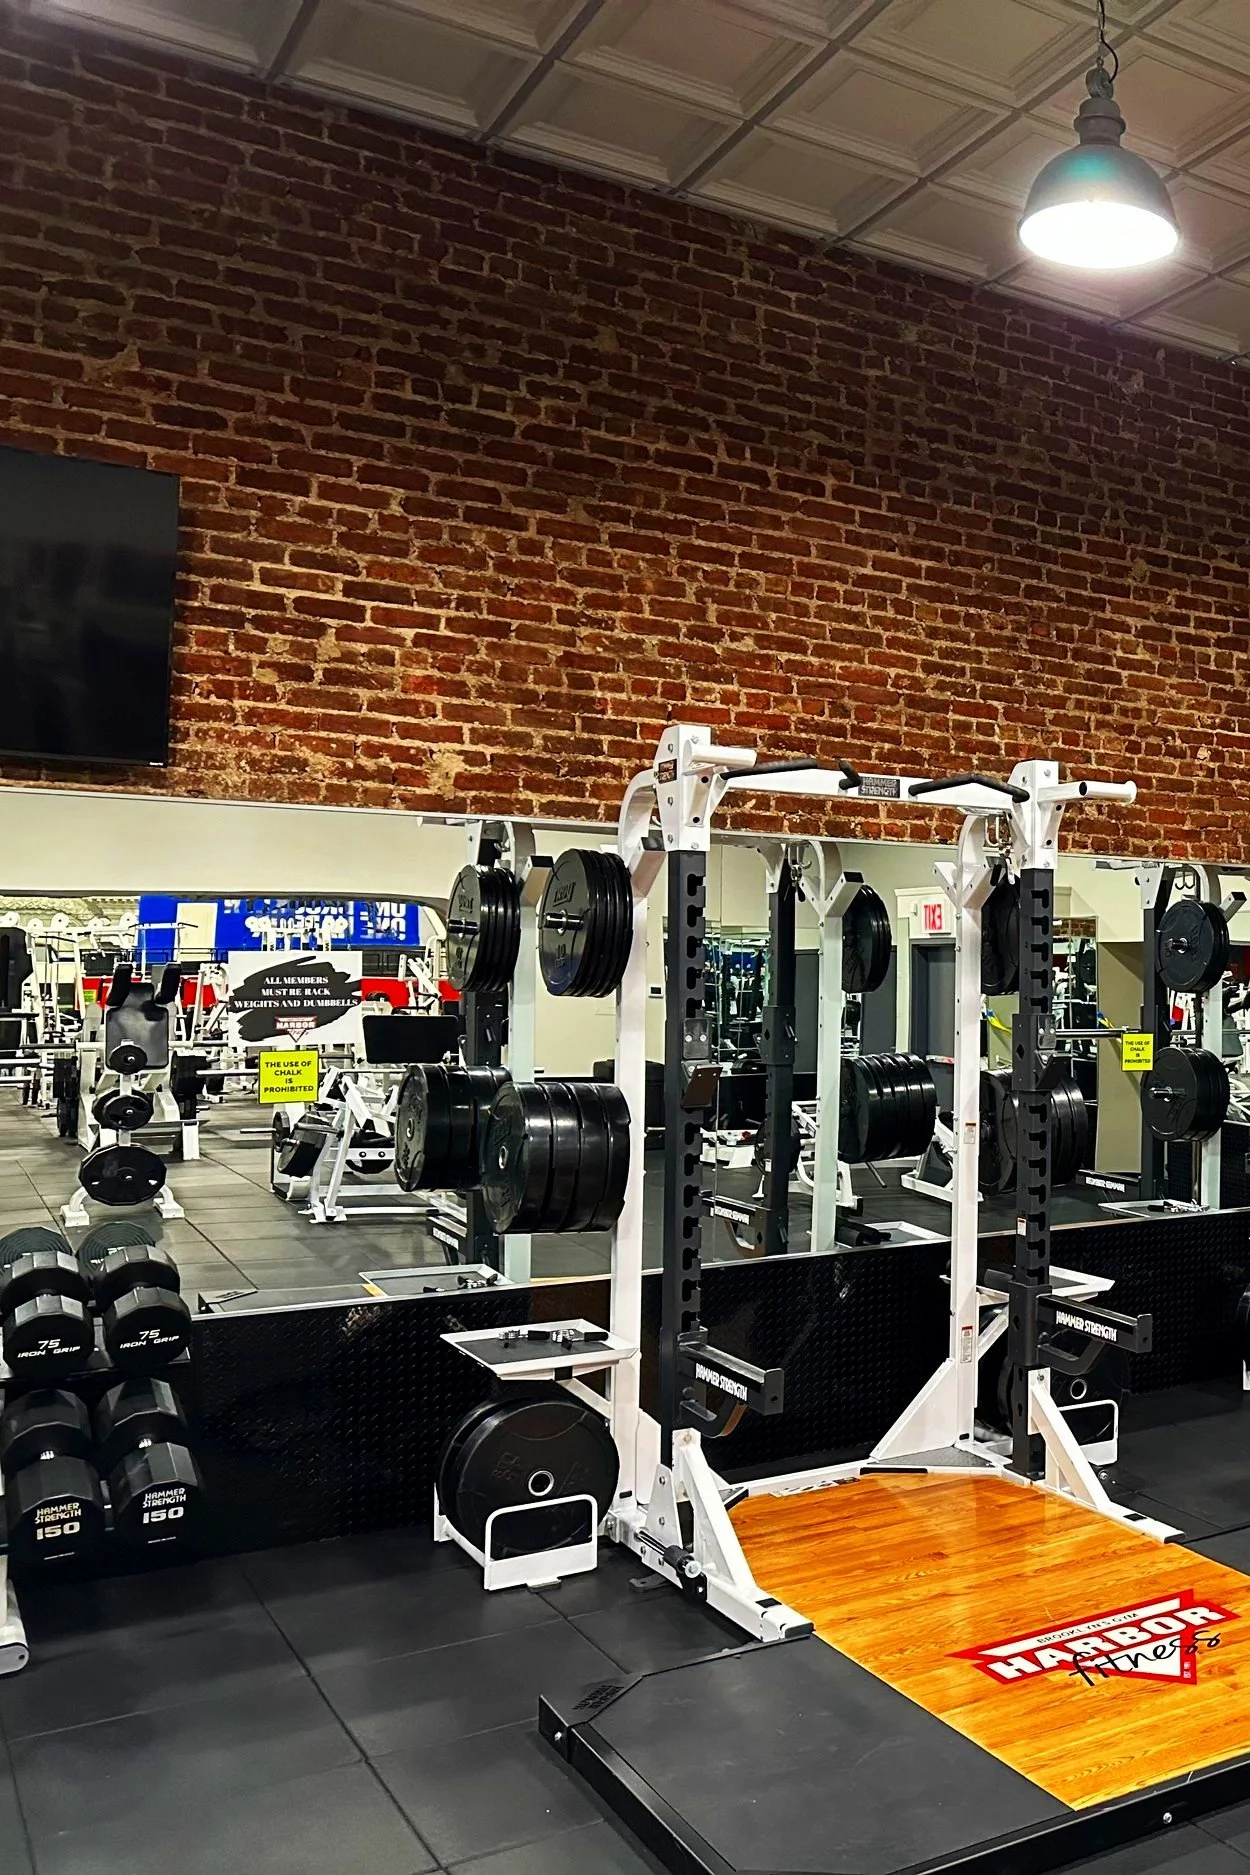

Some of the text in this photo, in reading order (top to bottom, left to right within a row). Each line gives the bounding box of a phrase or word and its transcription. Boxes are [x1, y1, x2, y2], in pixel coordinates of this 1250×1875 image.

[263, 976, 329, 985] ALL MEMBERS
[261, 988, 287, 996] MUST
[234, 999, 359, 1009] WEIGHTS AND DUMBBELLS
[276, 1021, 316, 1030] HARBOR
[263, 1085, 314, 1093] PROHIBITED
[1055, 1310, 1118, 1342] HAMMER STRENGTH
[139, 1328, 160, 1340] 75
[38, 1338, 61, 1349] 75
[120, 1335, 180, 1349] IRON GRIP
[17, 1345, 81, 1358] IRON GRIP
[142, 1494, 187, 1509] STRENGTH
[144, 1487, 186, 1502] HAMMER
[35, 1508, 82, 1524] STRENGTH
[36, 1502, 80, 1518] HAMMER
[142, 1506, 185, 1524] 150
[36, 1521, 81, 1541] 150
[1036, 1612, 1139, 1644] BROOKLYN'S GYM
[986, 1605, 1227, 1681] HARBOR
[1069, 1629, 1222, 1688] fitness
